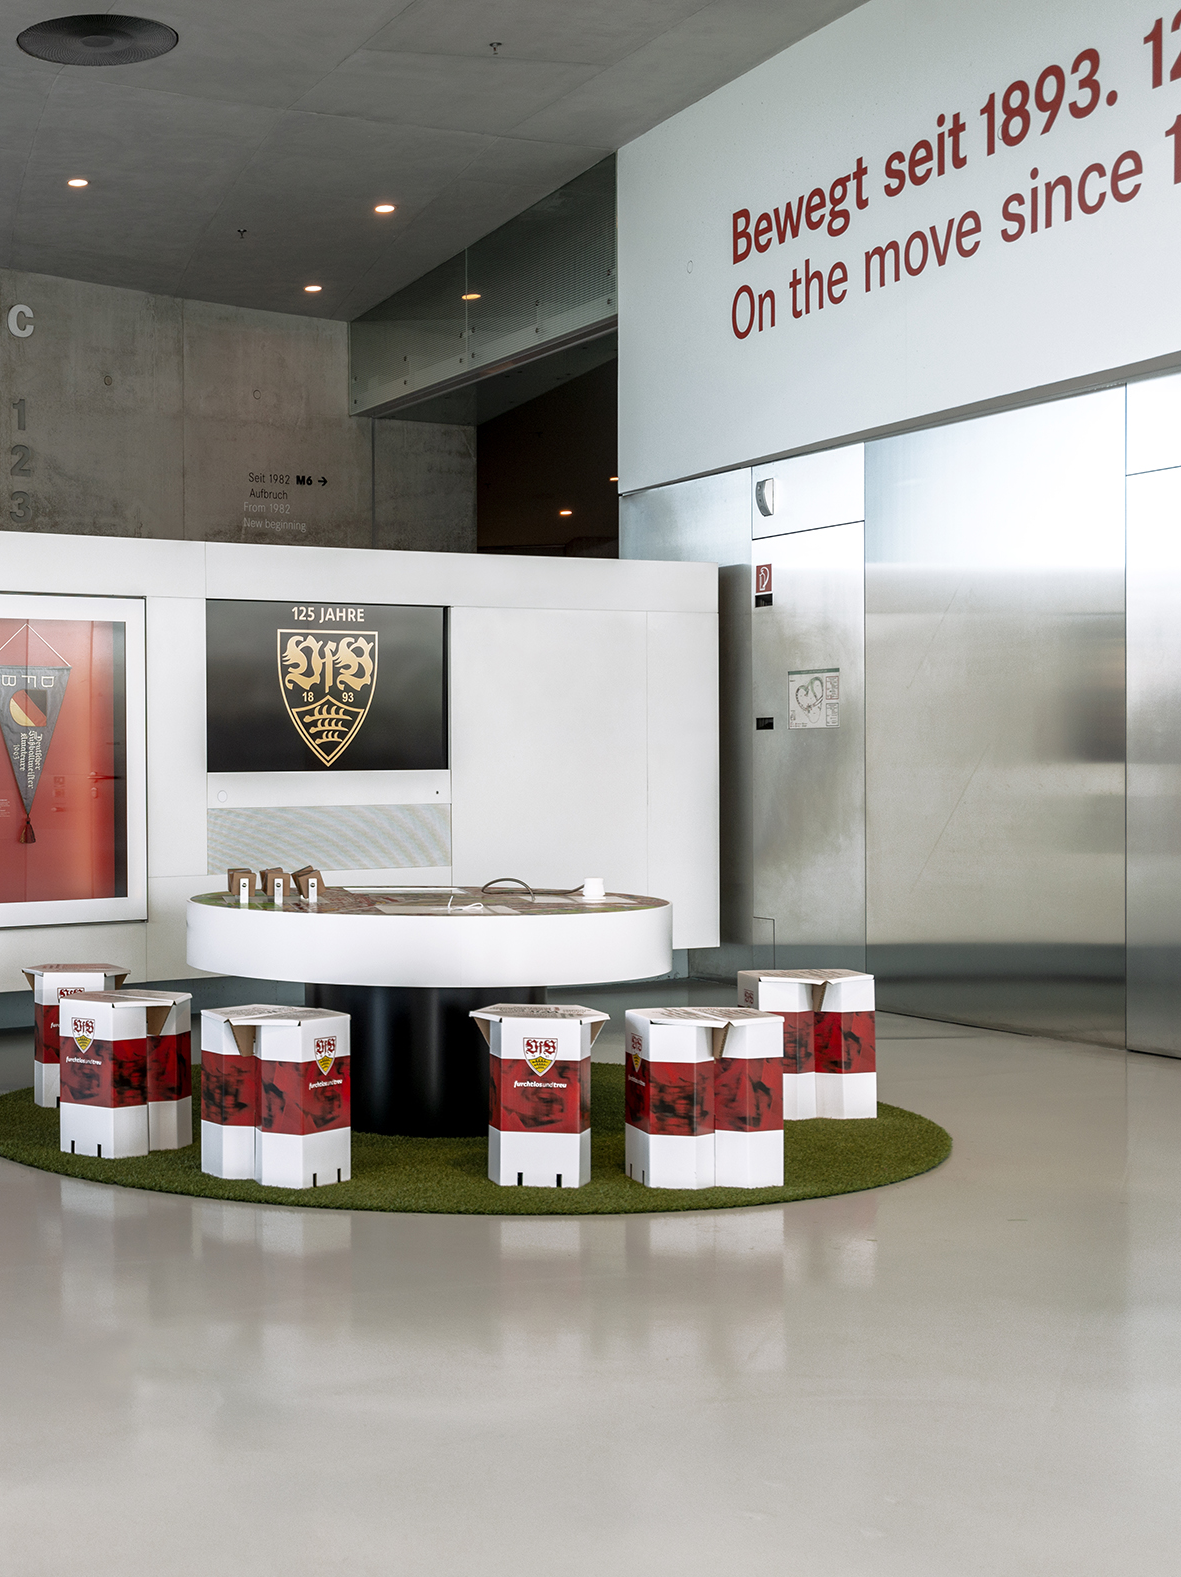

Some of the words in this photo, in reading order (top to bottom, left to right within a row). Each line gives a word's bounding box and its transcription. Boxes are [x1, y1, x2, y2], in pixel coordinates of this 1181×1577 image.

[731, 156, 870, 265] Bewegt
[883, 111, 967, 198] seit
[979, 47, 1119, 157] 1893.
[730, 283, 777, 341] On
[788, 257, 849, 320] the
[863, 209, 983, 294] move
[1000, 148, 1145, 243] since
[6, 303, 35, 338] C
[12, 398, 26, 431] 1
[10, 444, 32, 477] 2
[248, 472, 266, 484] Seit
[269, 474, 291, 485] 1982
[295, 475, 313, 486] M6
[9, 490, 33, 523] 3
[249, 488, 289, 500] Aufbruch
[243, 501, 266, 513] From
[269, 503, 291, 515] 1982
[243, 517, 263, 528] New
[264, 519, 307, 533] beginning
[291, 606, 315, 621] 125
[319, 607, 365, 623] JAHRE
[302, 691, 315, 703] 18
[341, 692, 355, 703] 93
